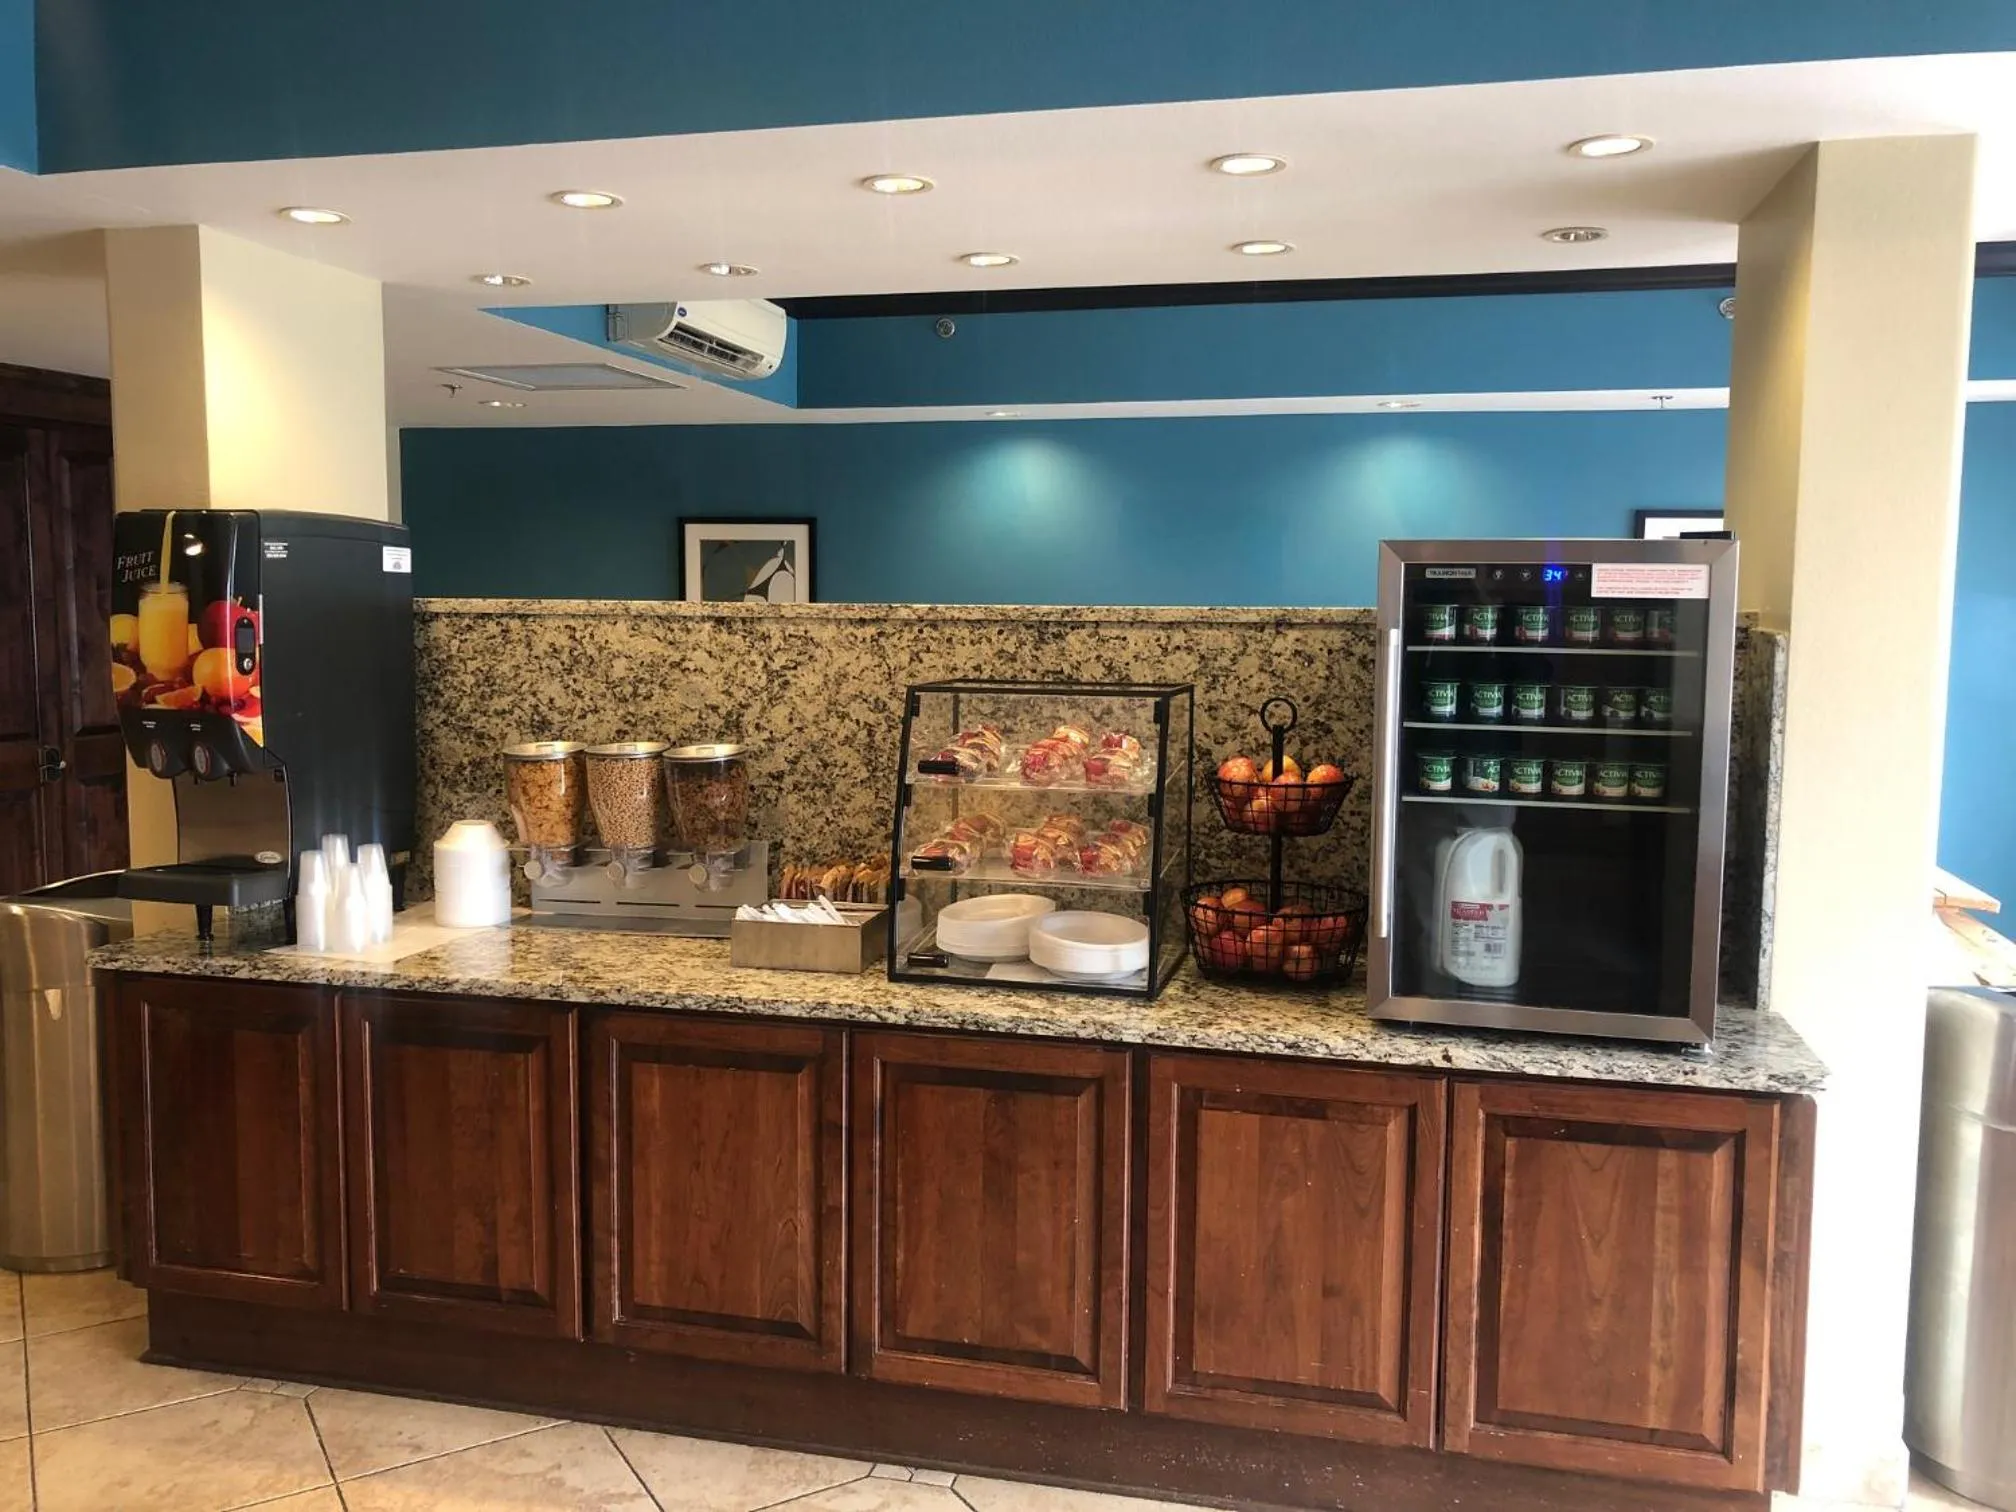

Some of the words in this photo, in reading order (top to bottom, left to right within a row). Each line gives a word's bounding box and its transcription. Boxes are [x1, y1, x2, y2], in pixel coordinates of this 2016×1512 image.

[117, 551, 154, 569] FRUIT
[121, 565, 156, 583] JUICE
[1544, 569, 1563, 582] 34
